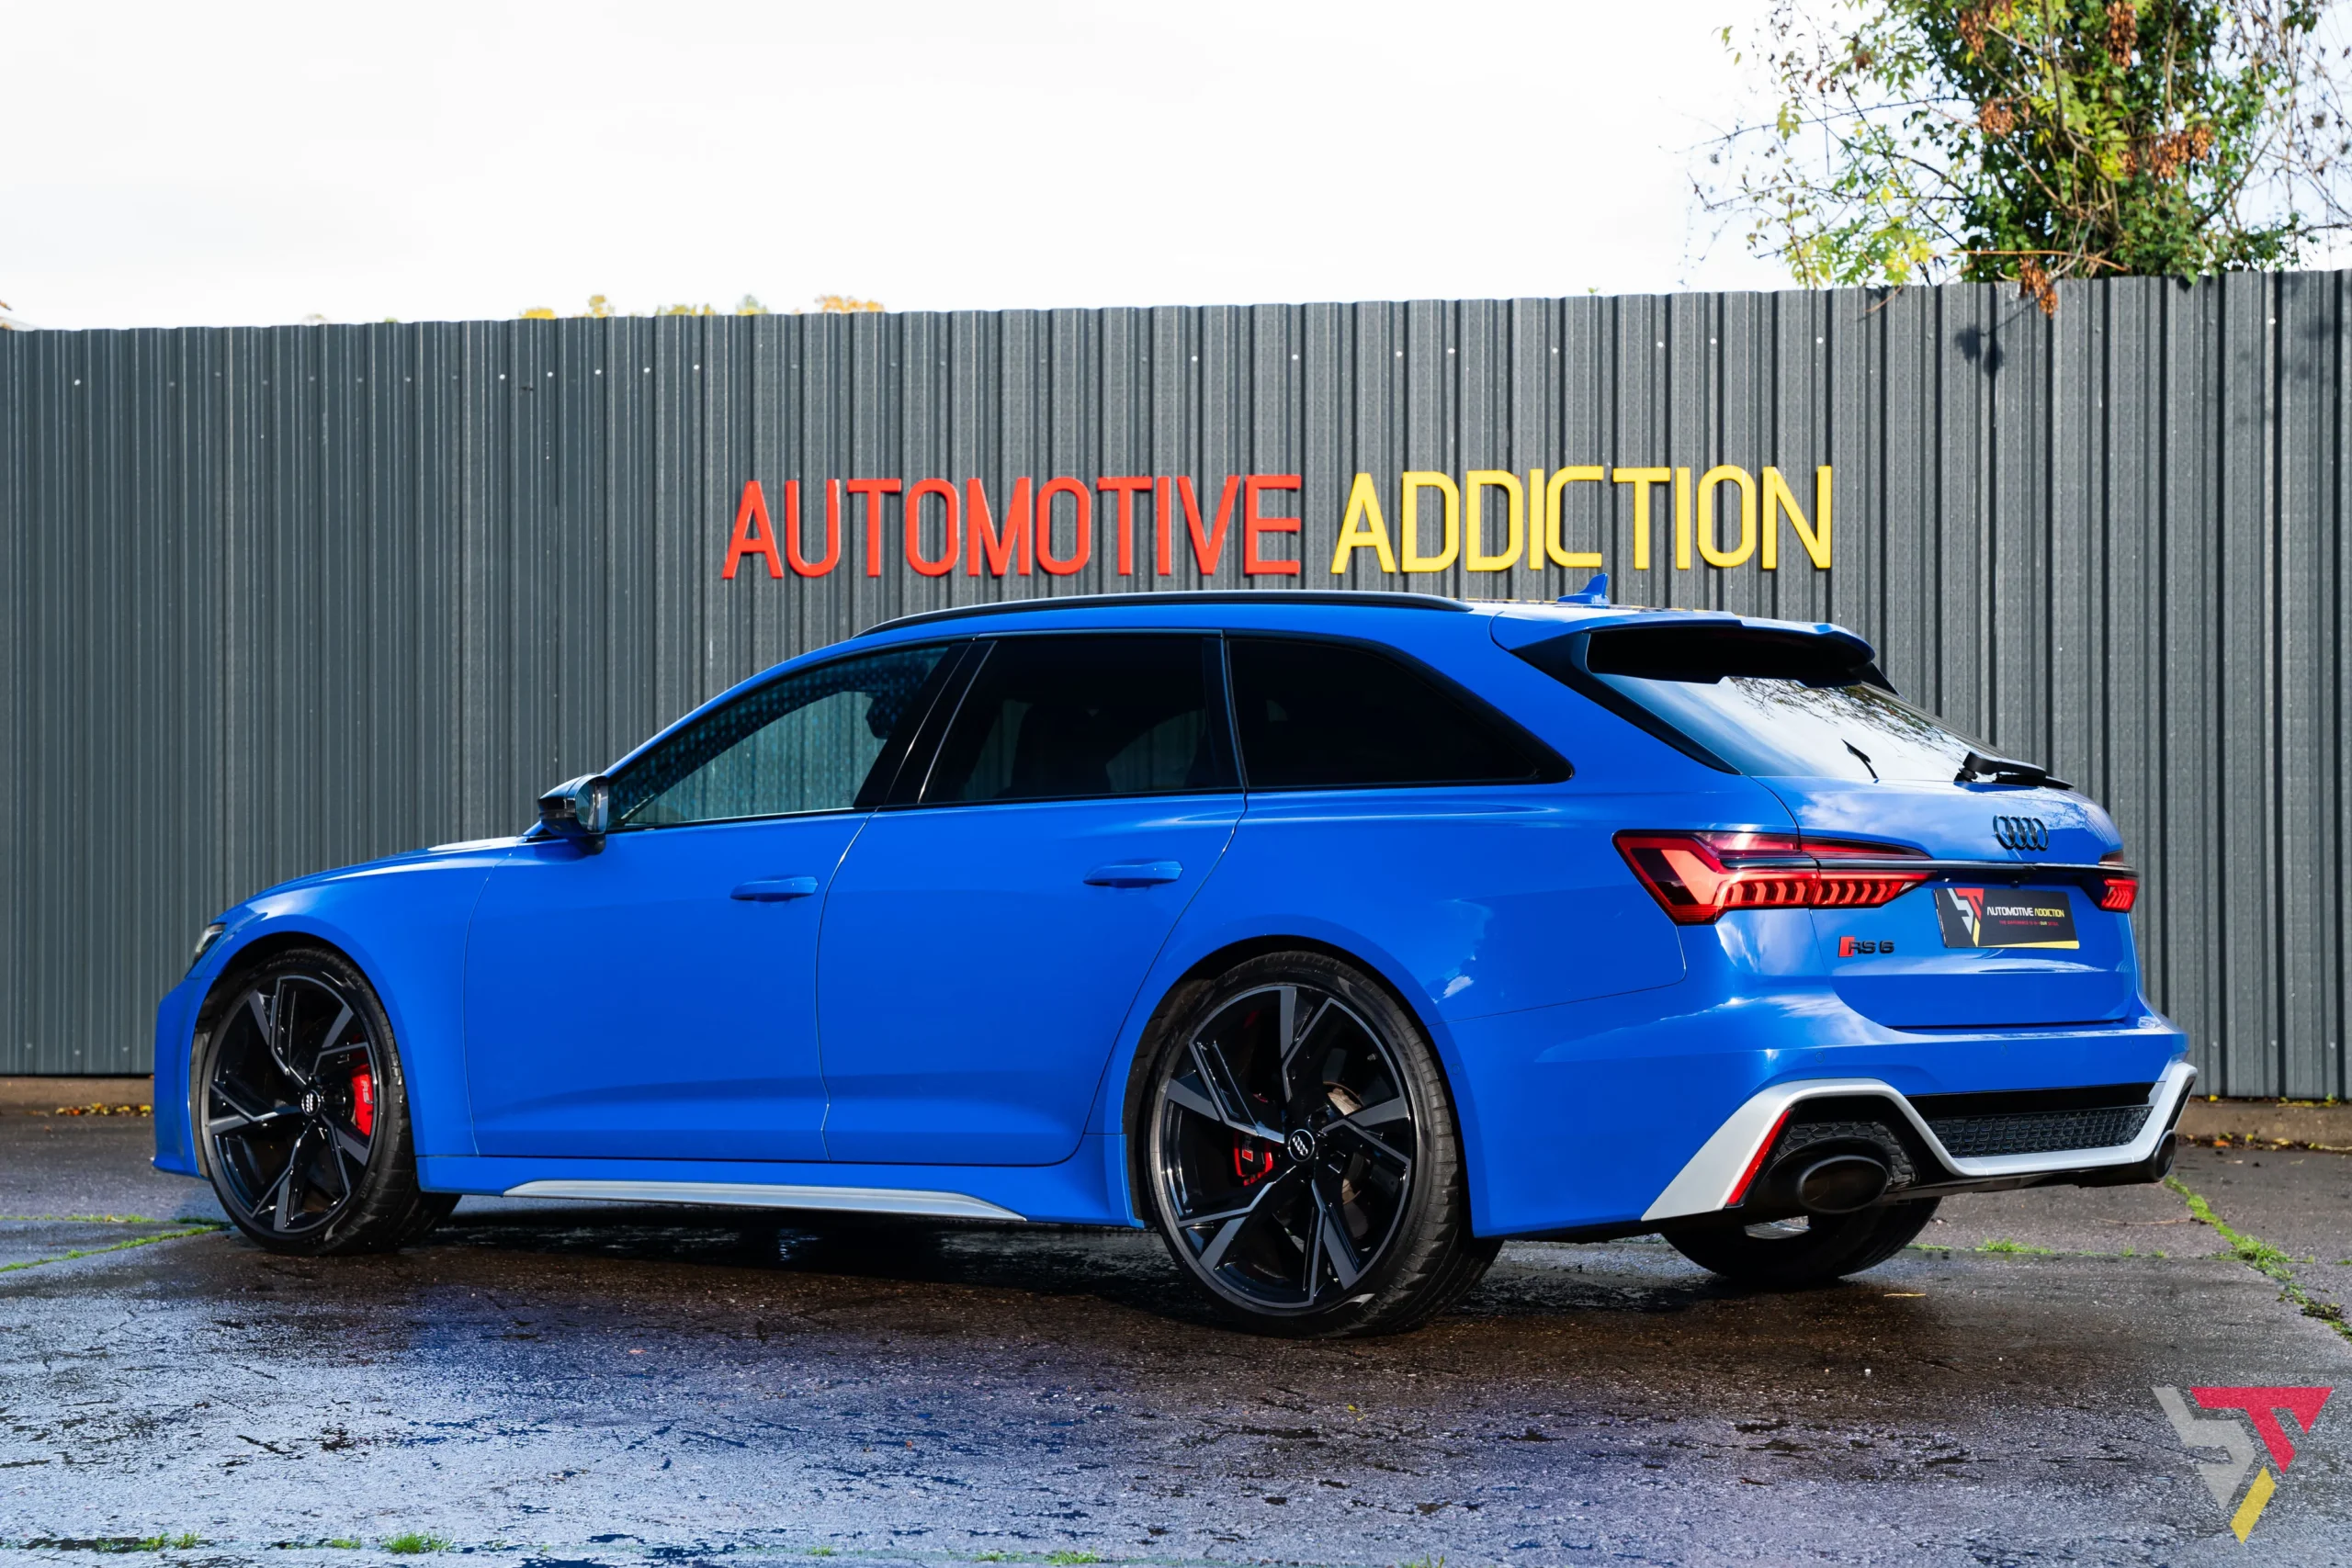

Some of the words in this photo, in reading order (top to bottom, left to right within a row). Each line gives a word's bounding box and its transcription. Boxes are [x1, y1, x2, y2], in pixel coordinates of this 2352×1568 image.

[721, 474, 1302, 580] AUTOMOTIVE
[1330, 464, 1833, 574] ADDICTION
[1986, 907, 2034, 917] AUTOMOTIVE
[2034, 908, 2065, 918] ADDICTION
